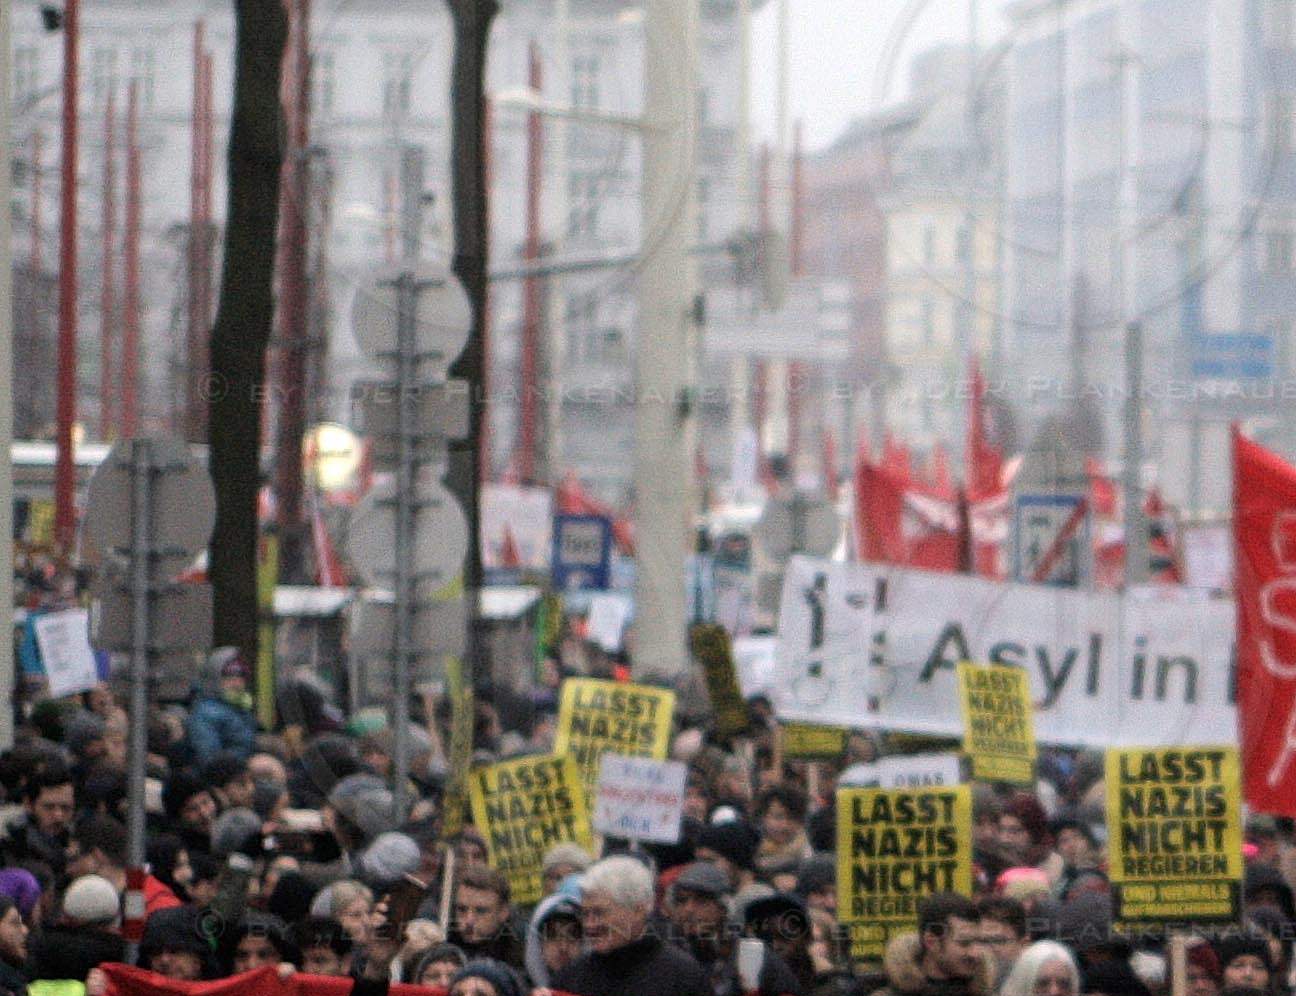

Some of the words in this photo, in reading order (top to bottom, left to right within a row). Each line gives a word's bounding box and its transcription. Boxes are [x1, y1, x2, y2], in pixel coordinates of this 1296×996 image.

[917, 621, 1104, 711] Asyl
[1129, 635, 1197, 701] in
[574, 688, 660, 719] LASST
[570, 715, 657, 744] NAZIS
[478, 758, 567, 796] LASST
[1120, 751, 1225, 783] LASST
[486, 787, 573, 824] NAZIS
[851, 794, 957, 824] LASST
[1120, 784, 1227, 817] NAZIS
[491, 816, 576, 852] NICHT
[851, 826, 958, 857] NAZIS
[1121, 819, 1228, 853] NICHT
[851, 860, 958, 893] NICHT
[1123, 855, 1228, 875] REGIEREN
